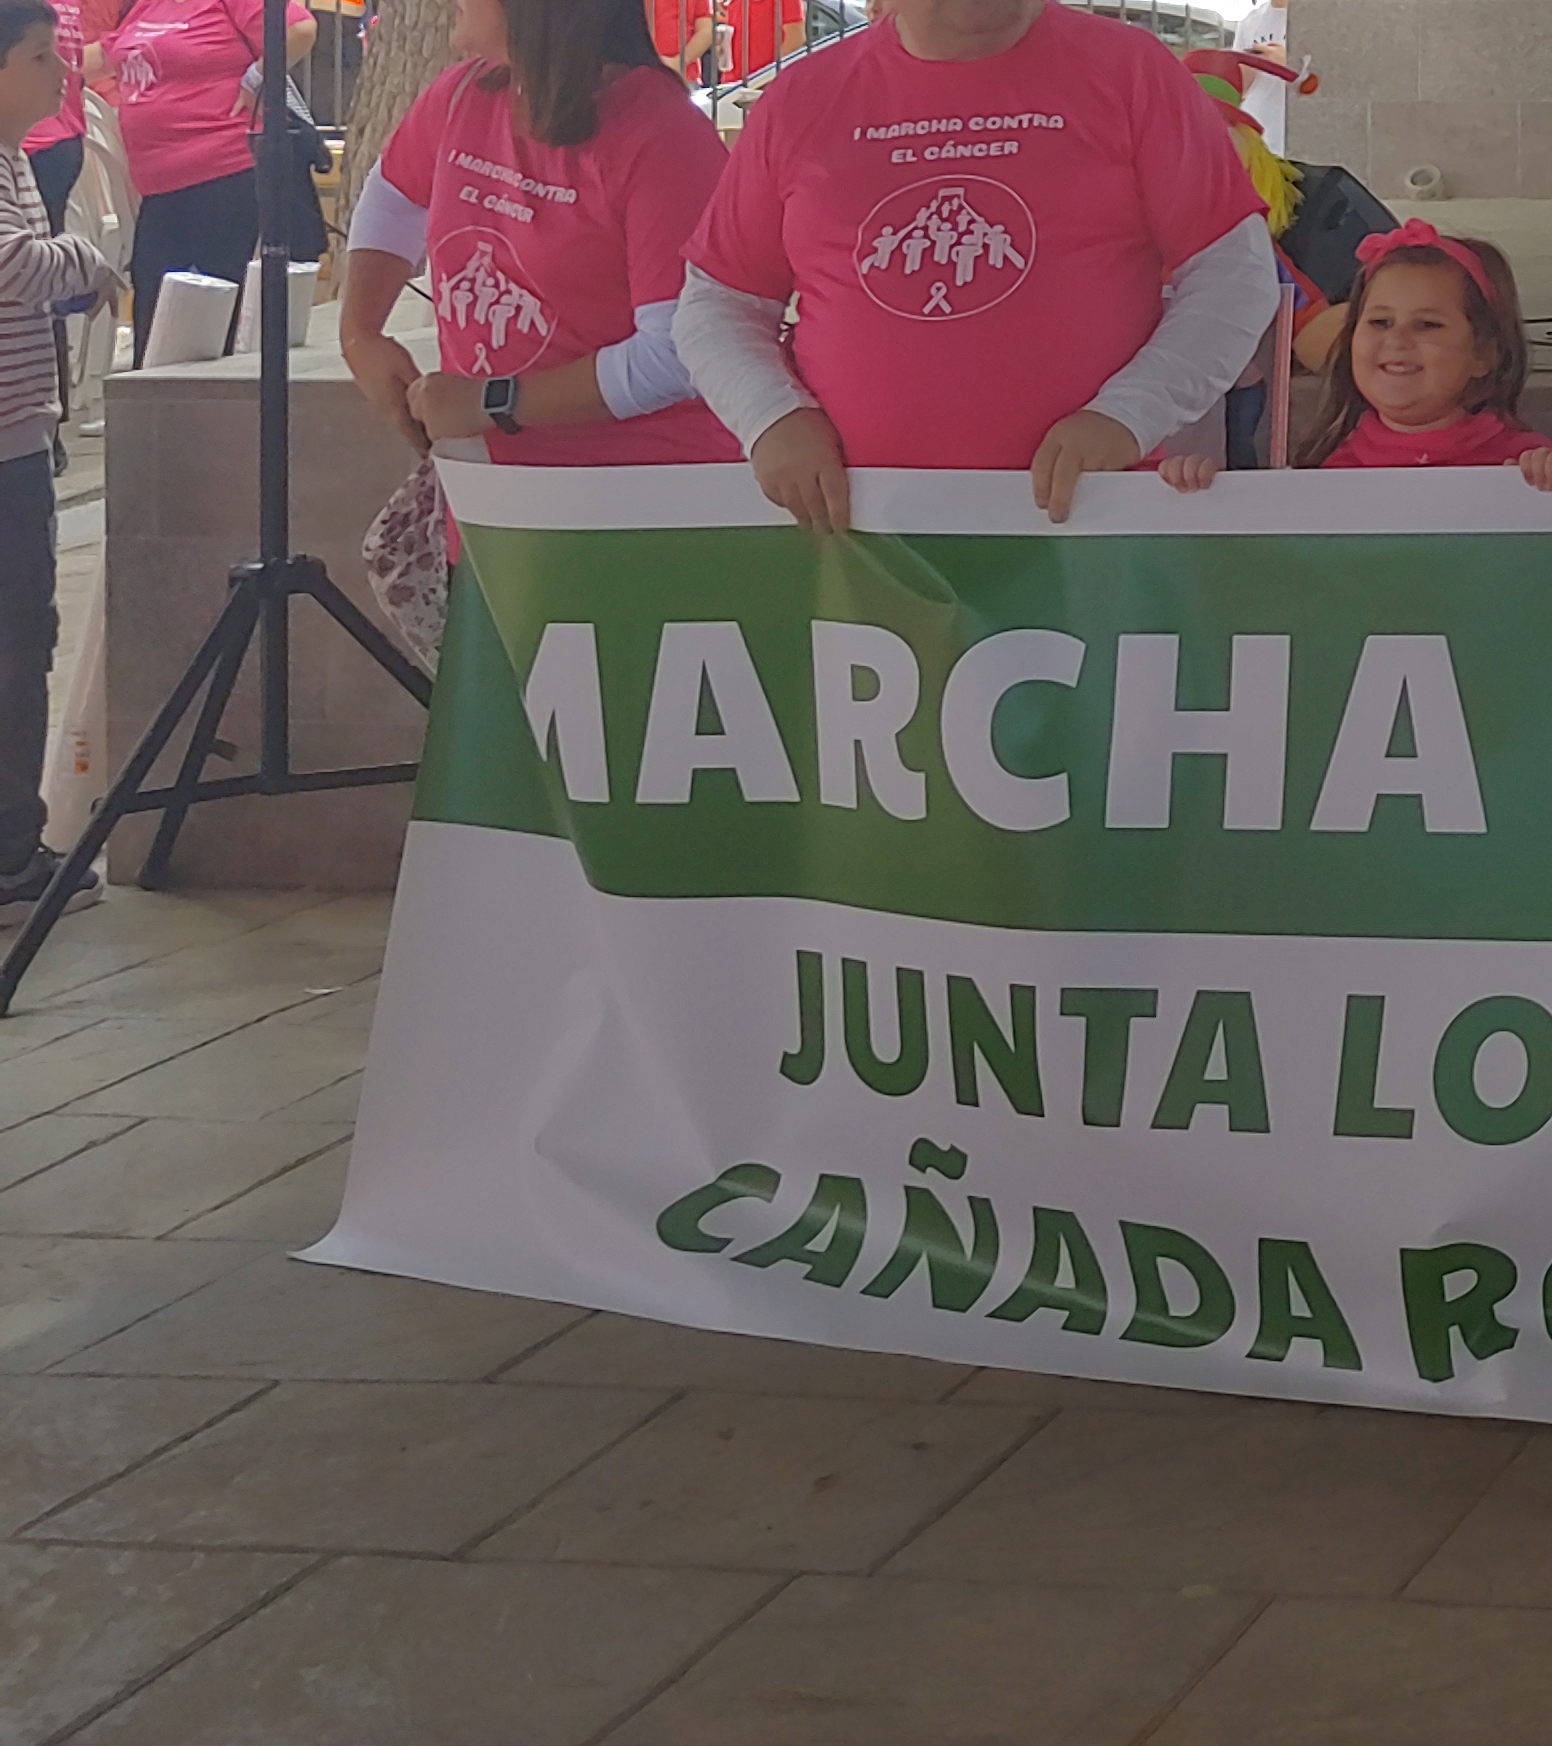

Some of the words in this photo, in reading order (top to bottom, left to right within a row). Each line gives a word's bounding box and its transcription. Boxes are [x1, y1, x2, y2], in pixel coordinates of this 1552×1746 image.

[865, 117, 963, 140] MARCHA
[968, 113, 1065, 131] CONTRA
[891, 149, 918, 163] EL
[923, 140, 1019, 161] CÁNCER
[459, 185, 480, 204] EL
[778, 948, 1271, 1134] JUNTA
[655, 1136, 1363, 1371] CAÑADA
